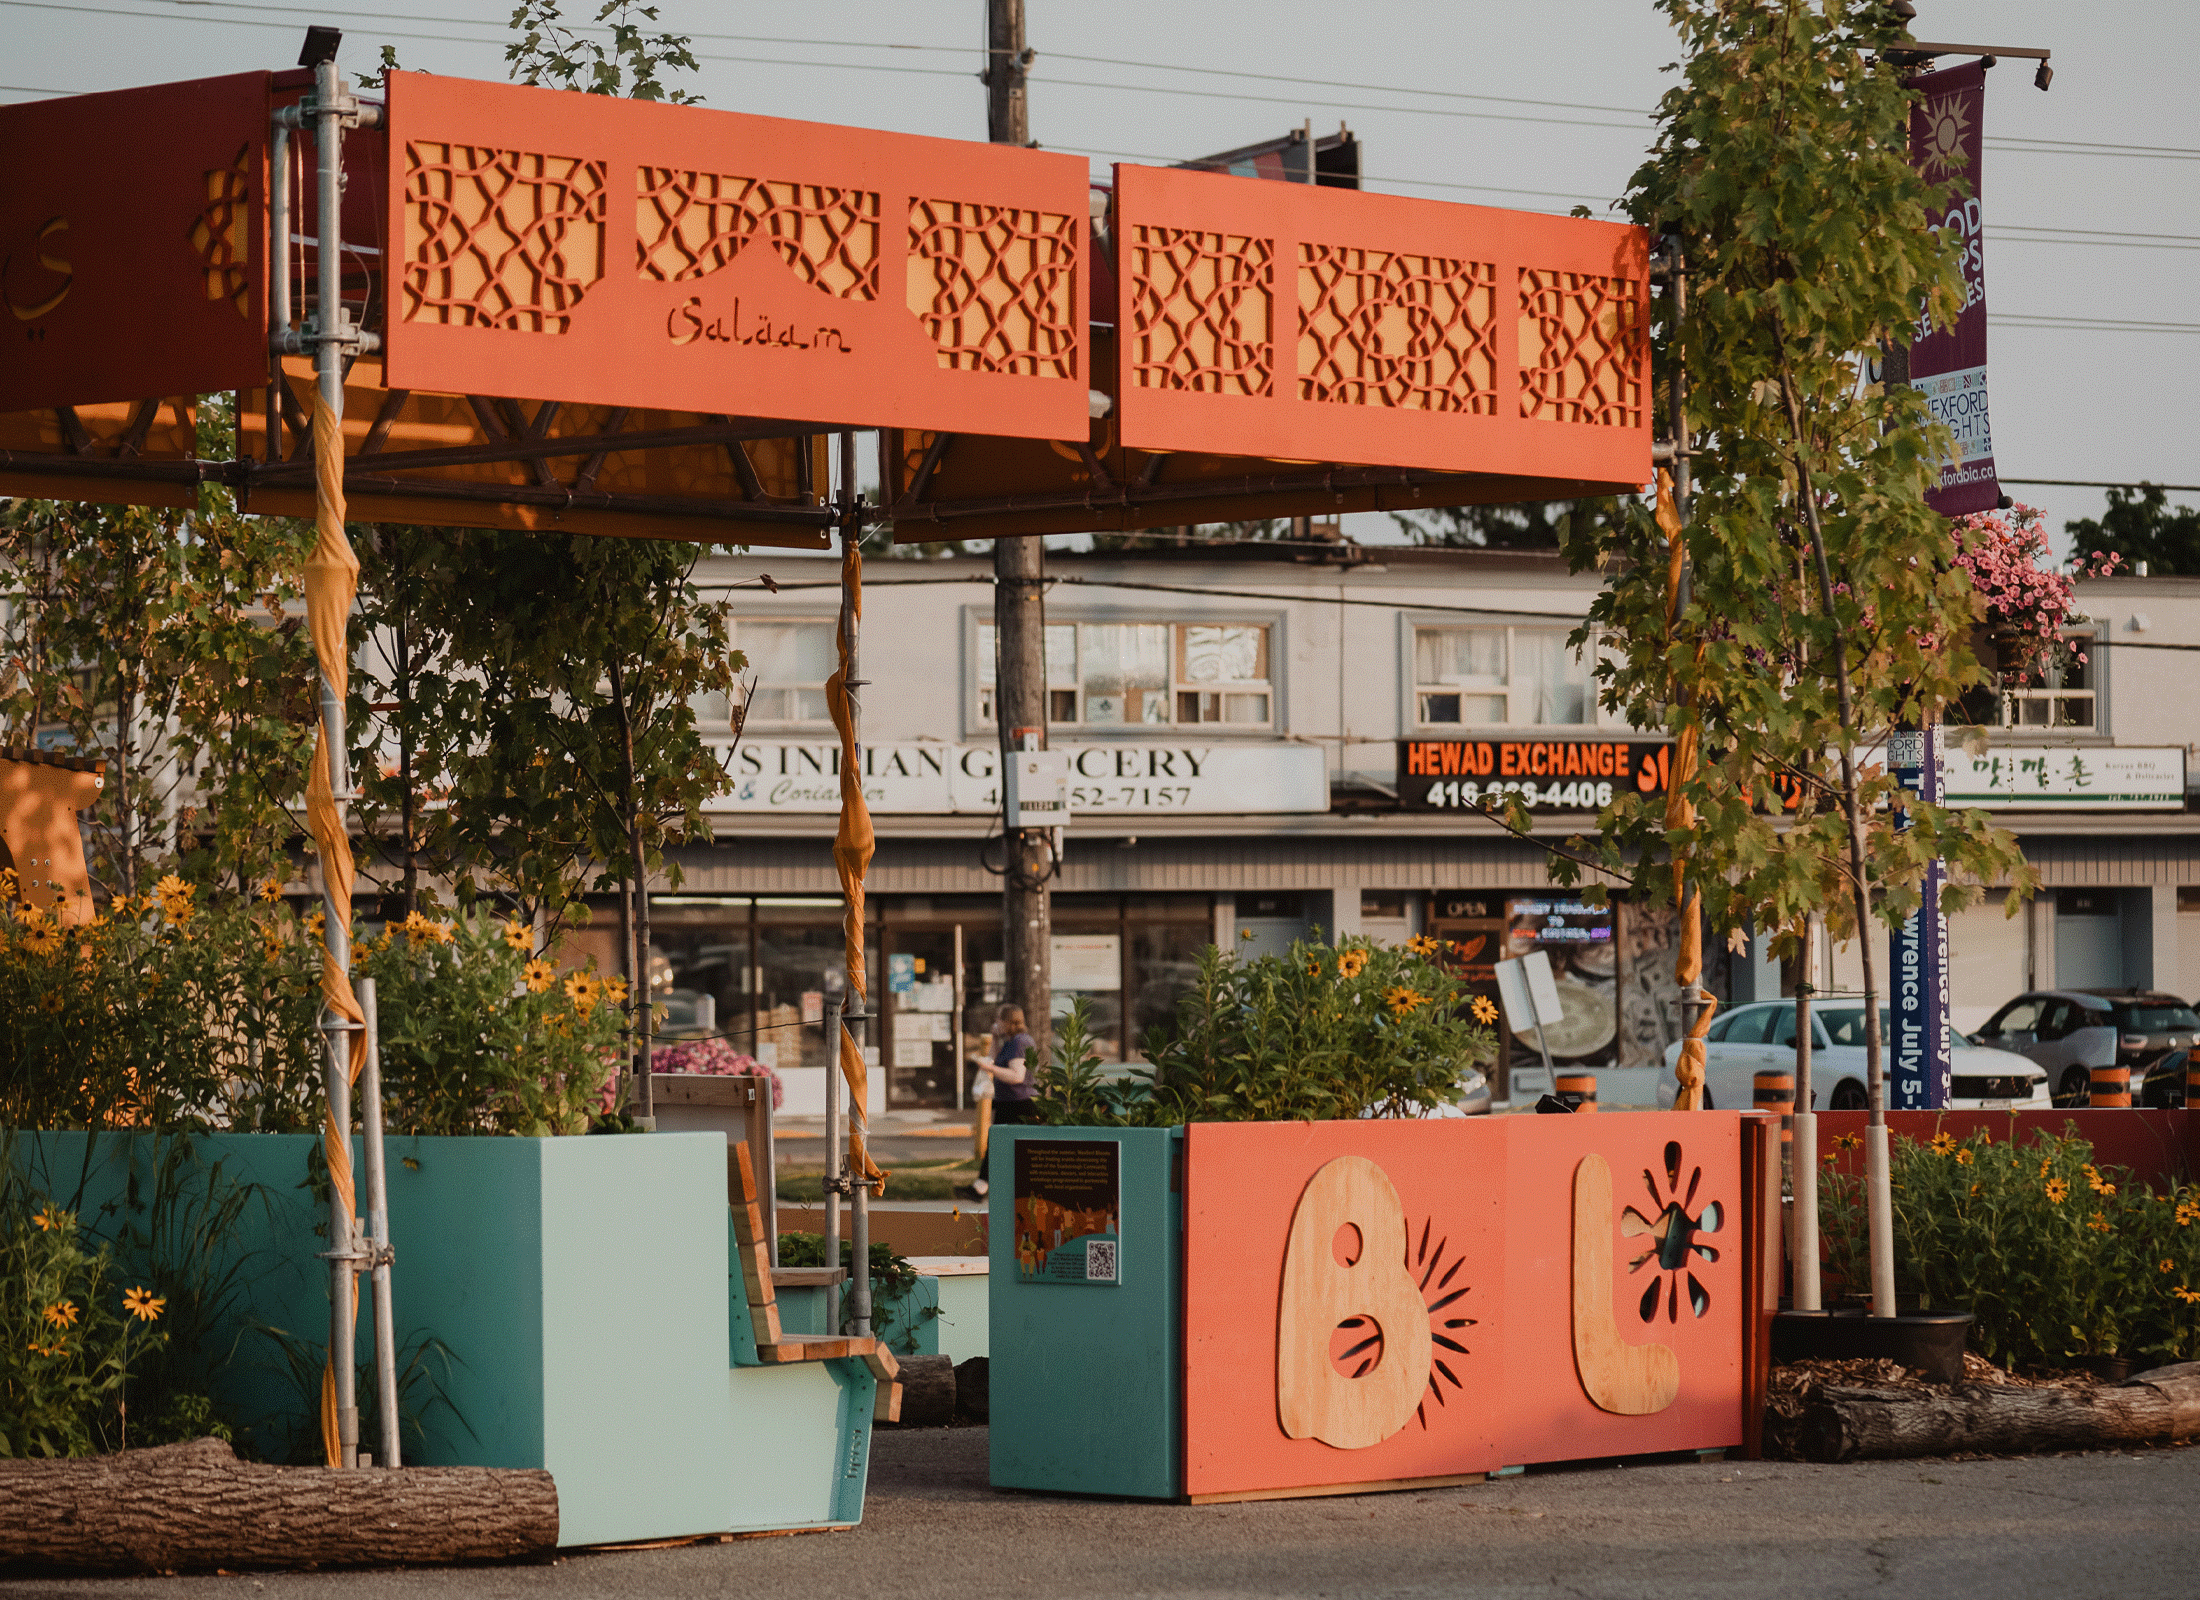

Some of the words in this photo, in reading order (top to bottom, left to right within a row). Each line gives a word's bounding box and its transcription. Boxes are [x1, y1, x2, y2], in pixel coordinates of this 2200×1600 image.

[960, 747, 1211, 778] GCERY
[1408, 742, 1494, 776] HEWAD
[1500, 742, 1630, 777] EXCHANGE
[1448, 901, 1487, 916] OPEN
[1898, 1017, 1923, 1073] July
